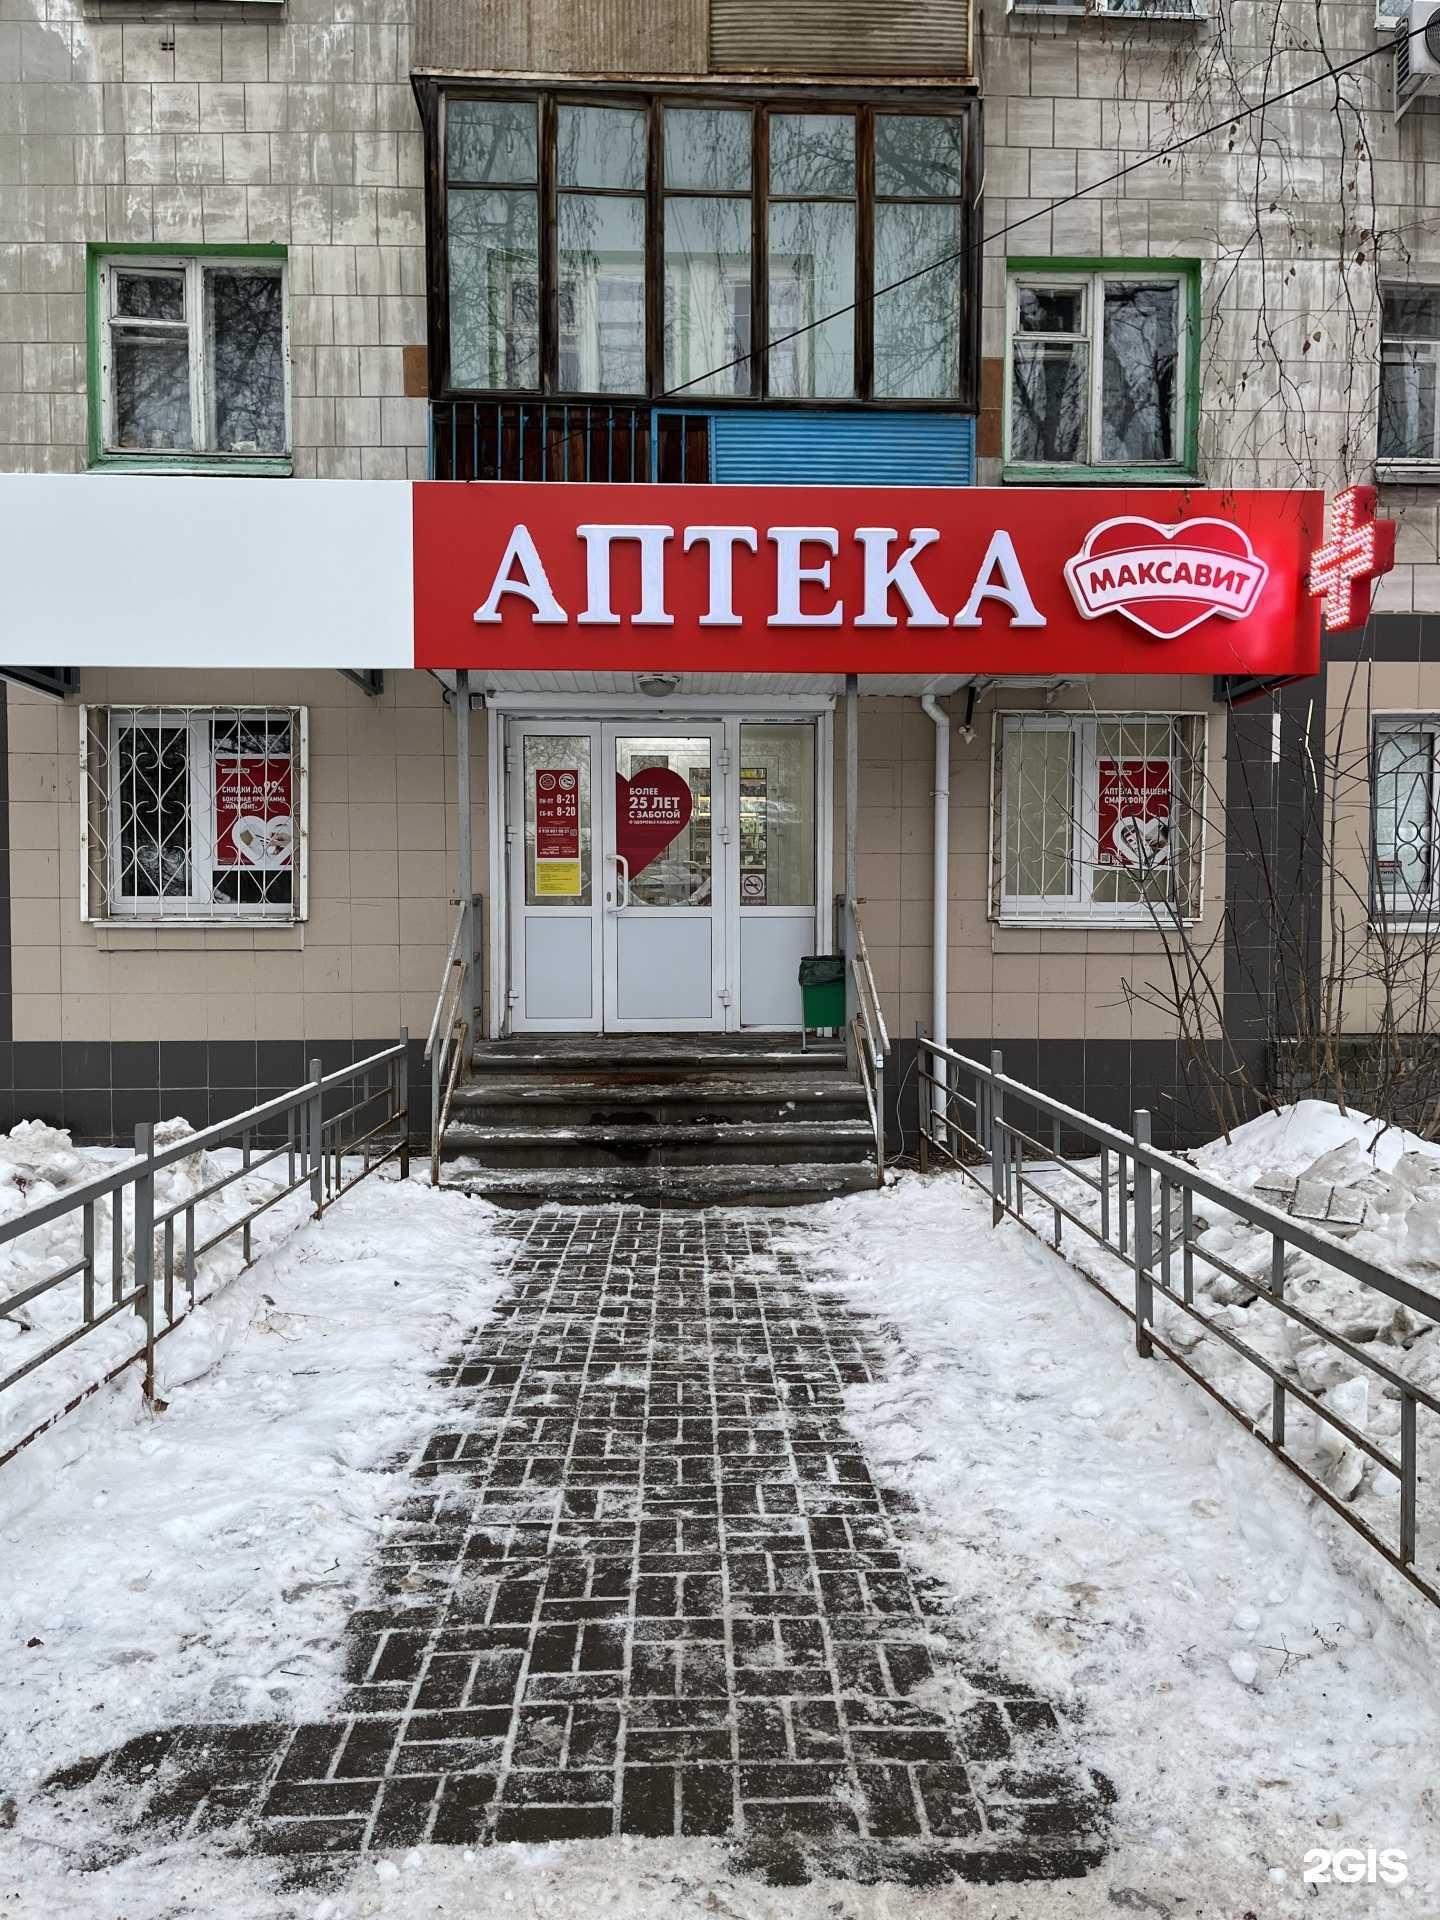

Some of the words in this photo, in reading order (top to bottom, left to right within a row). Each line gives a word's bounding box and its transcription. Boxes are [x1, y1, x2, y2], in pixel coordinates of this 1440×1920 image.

[473, 523, 1048, 628] АПТЕКА
[1089, 560, 1251, 596] МАКСАВИТ
[252, 786, 263, 794] ДО
[629, 787, 659, 796] БОЛЕЕ
[556, 793, 576, 804] 8-21
[629, 796, 648, 809] 25
[651, 796, 680, 809] ЛЕТ
[556, 806, 576, 817] 8-20
[628, 810, 635, 818] С
[636, 809, 681, 818] ЗАБОТОЙ
